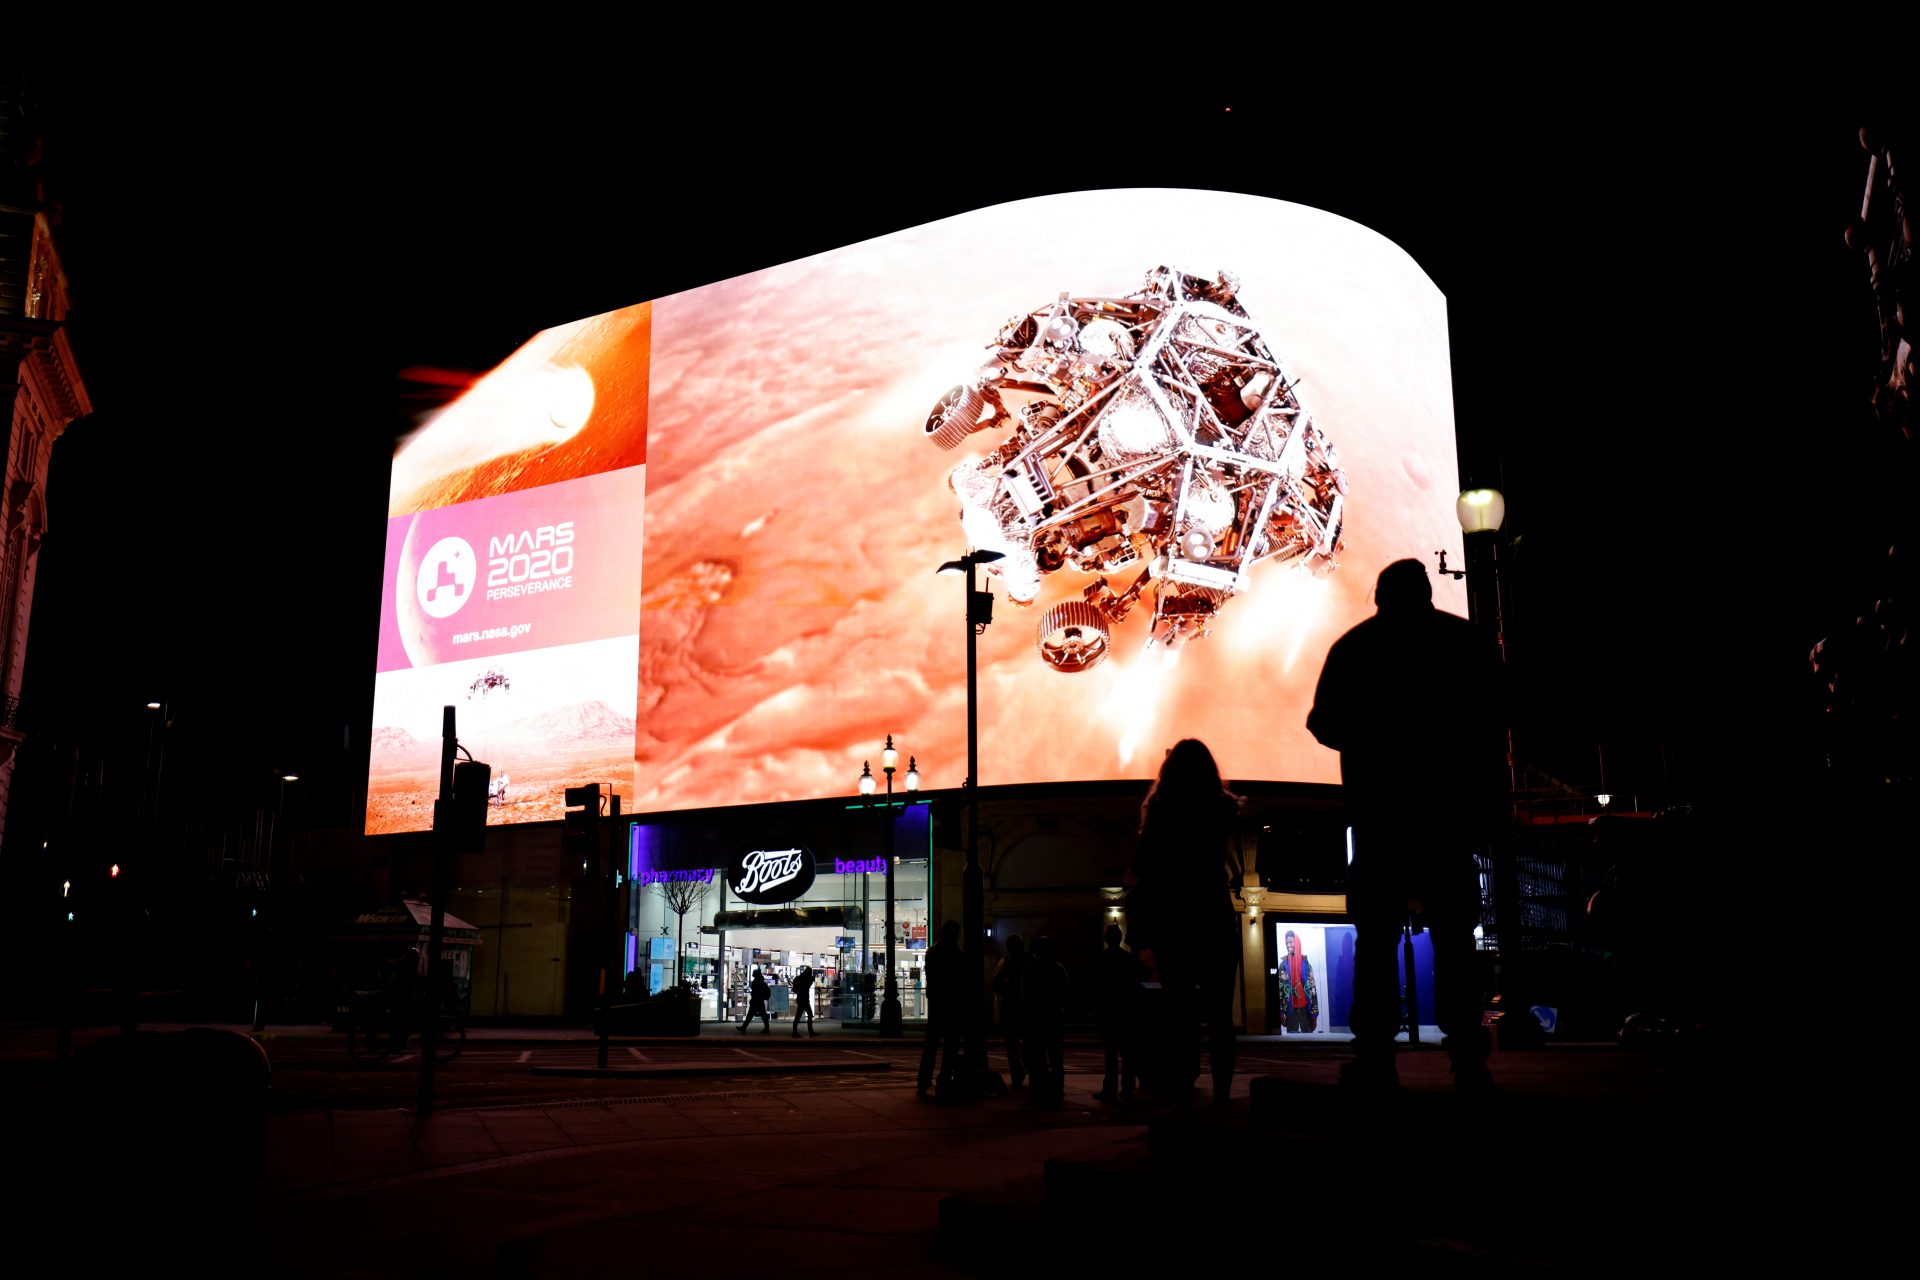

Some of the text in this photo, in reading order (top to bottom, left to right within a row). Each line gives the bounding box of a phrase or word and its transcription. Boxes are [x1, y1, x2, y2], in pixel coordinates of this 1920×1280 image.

[489, 521, 575, 558] MARS
[487, 546, 574, 587] 2020
[486, 576, 573, 601] PERSEVERANCE
[452, 622, 531, 644] mars.nasa.gov
[641, 867, 714, 887] pharmacy
[734, 848, 803, 894] Boots
